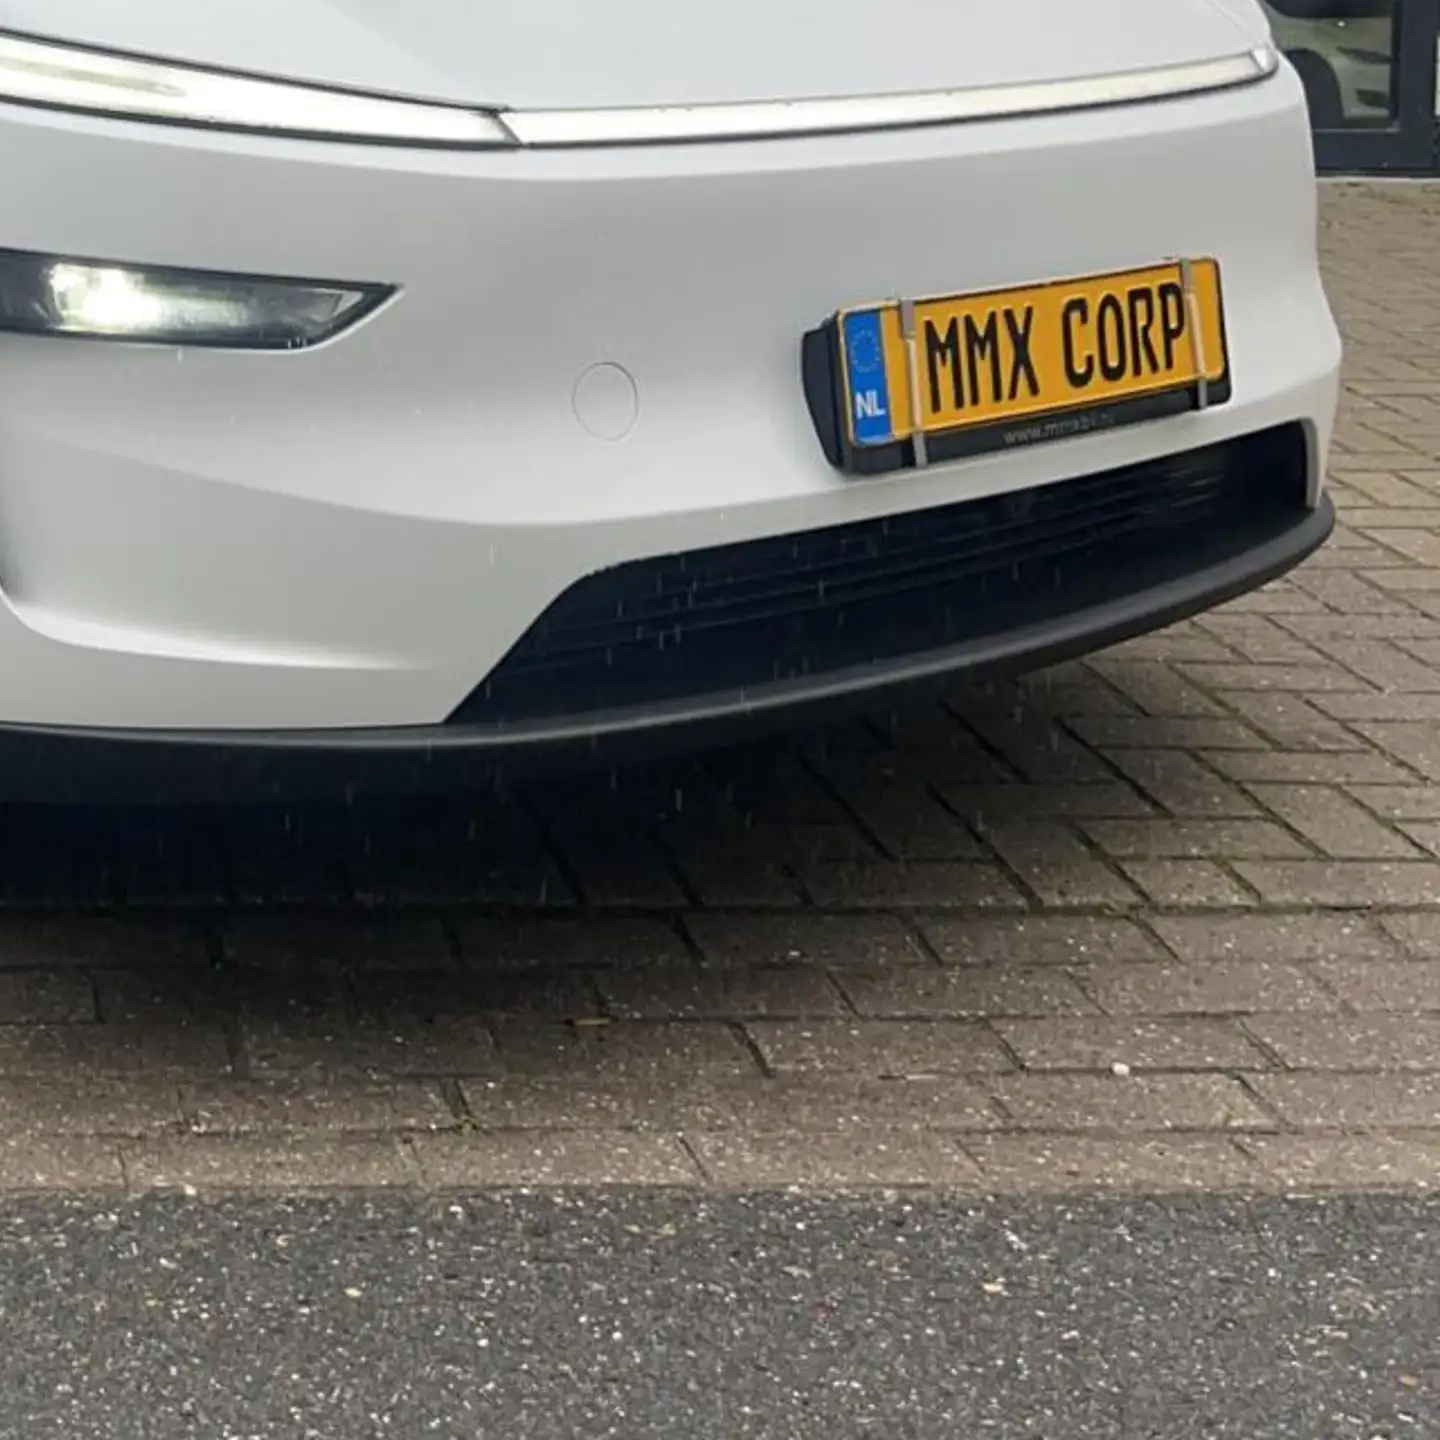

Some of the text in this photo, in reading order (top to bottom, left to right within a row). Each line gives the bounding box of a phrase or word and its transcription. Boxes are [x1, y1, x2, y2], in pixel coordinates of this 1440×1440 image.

[924, 281, 1185, 413] MMX CORP
[855, 389, 886, 421] NL
